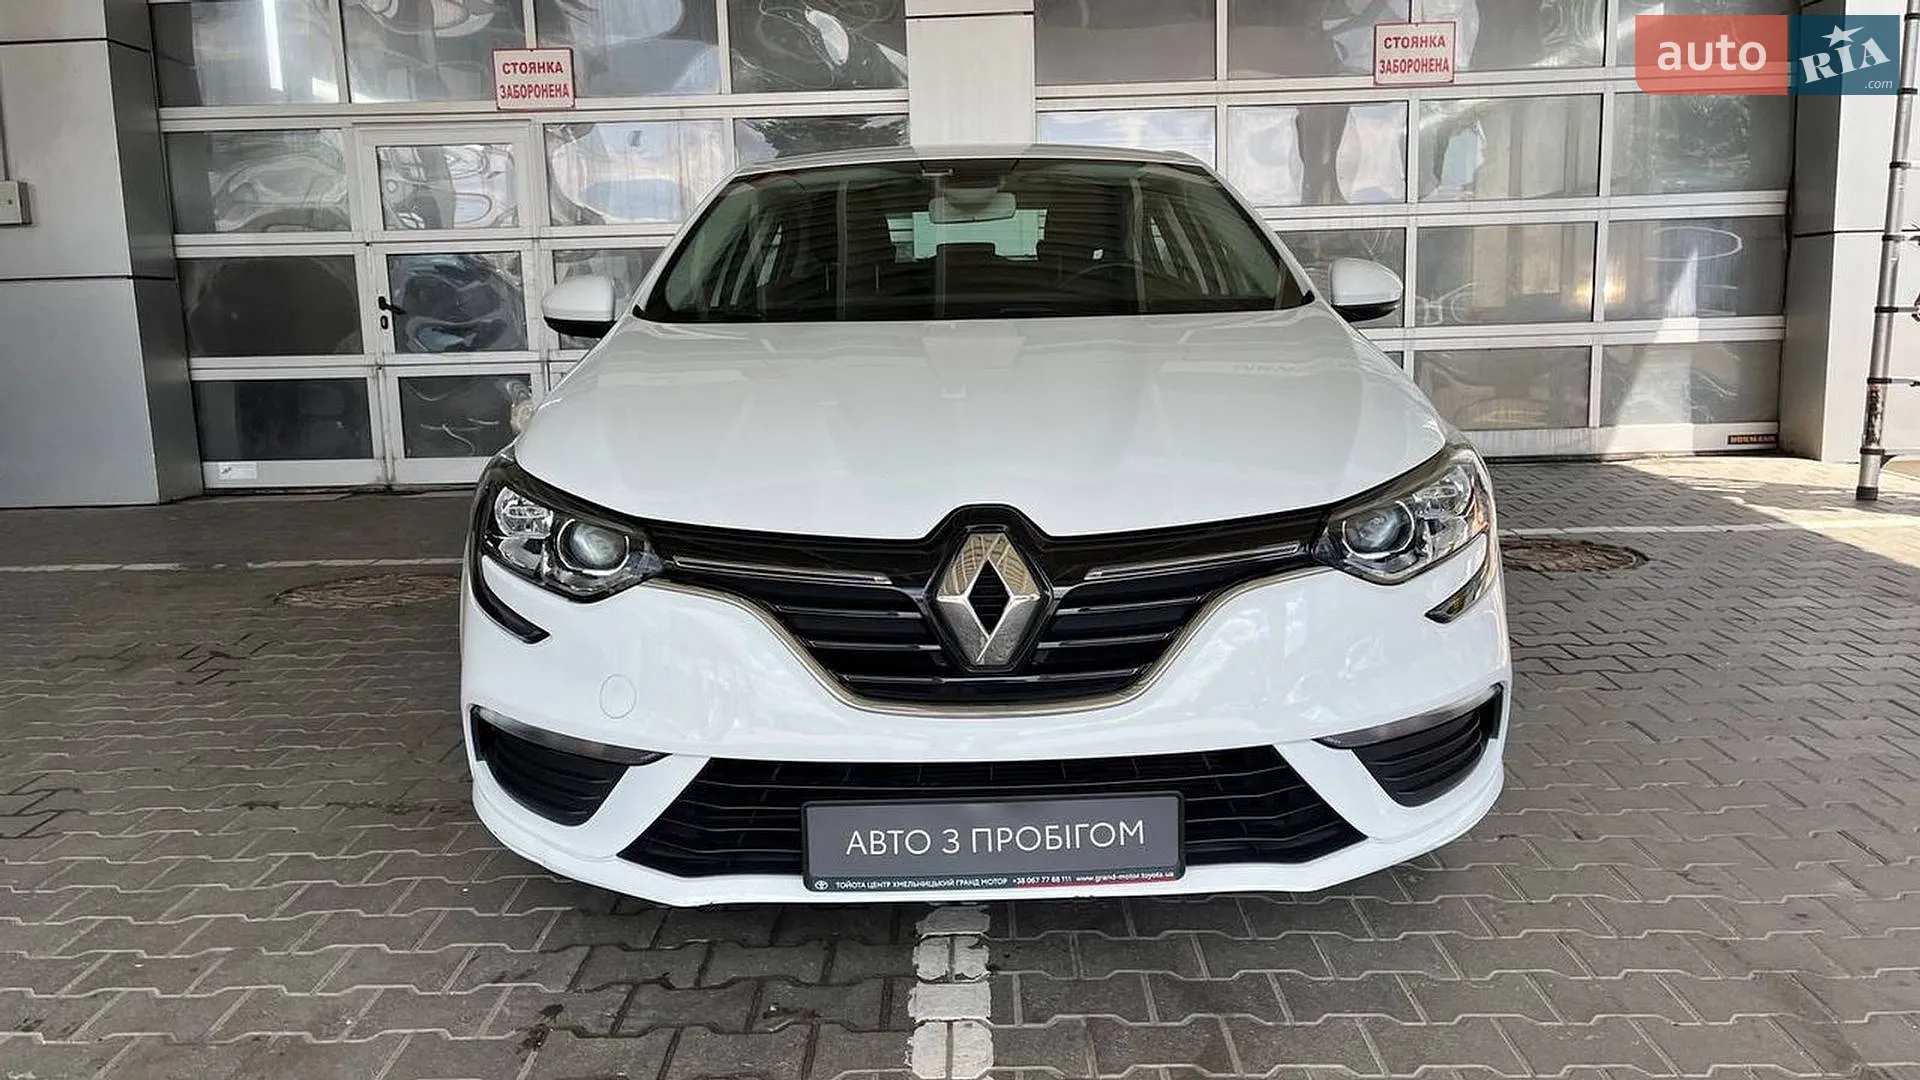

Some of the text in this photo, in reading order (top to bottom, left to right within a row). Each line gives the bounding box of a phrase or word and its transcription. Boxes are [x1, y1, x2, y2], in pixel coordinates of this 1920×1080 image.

[1384, 35, 1446, 49] СТОЯНКА
[502, 61, 564, 75] СТОЯНКА
[1380, 57, 1449, 74] ЗАБОРОНЕНА
[499, 83, 570, 99] ЗАБОРОНЕНА
[846, 828, 932, 856] АВТО
[970, 819, 1145, 854] ПРОБІГОМ
[835, 880, 866, 889] ТОЙОТА
[867, 880, 890, 889] ЦЕНТР
[956, 878, 981, 887] ГРАНД
[981, 877, 1008, 886] МОТОР
